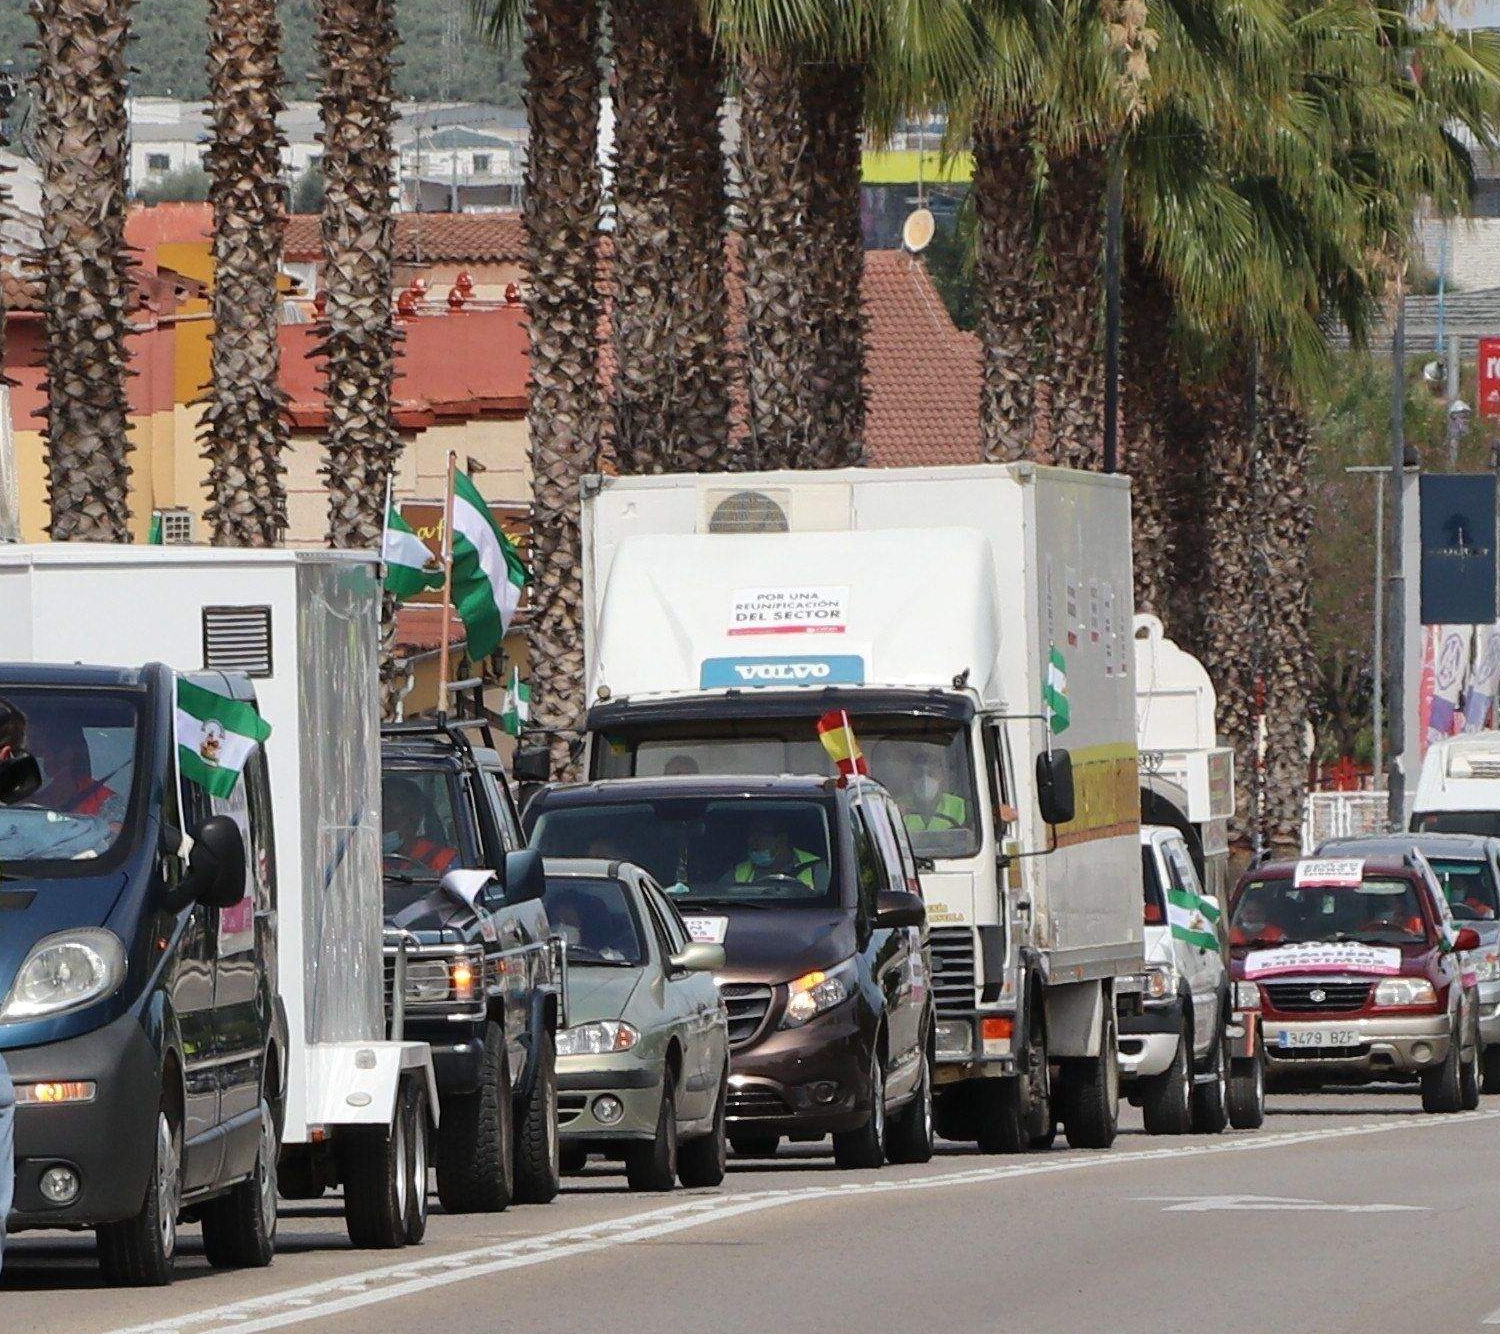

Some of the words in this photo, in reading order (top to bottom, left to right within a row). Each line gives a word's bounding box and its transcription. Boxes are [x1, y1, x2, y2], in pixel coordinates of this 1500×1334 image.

[757, 593, 785, 601] POR
[789, 592, 819, 600] UNA
[735, 599, 839, 611] REUNIFICACIÓN
[735, 612, 767, 622] DEL
[773, 609, 841, 621] SECTOR
[734, 663, 831, 680] VOLVO
